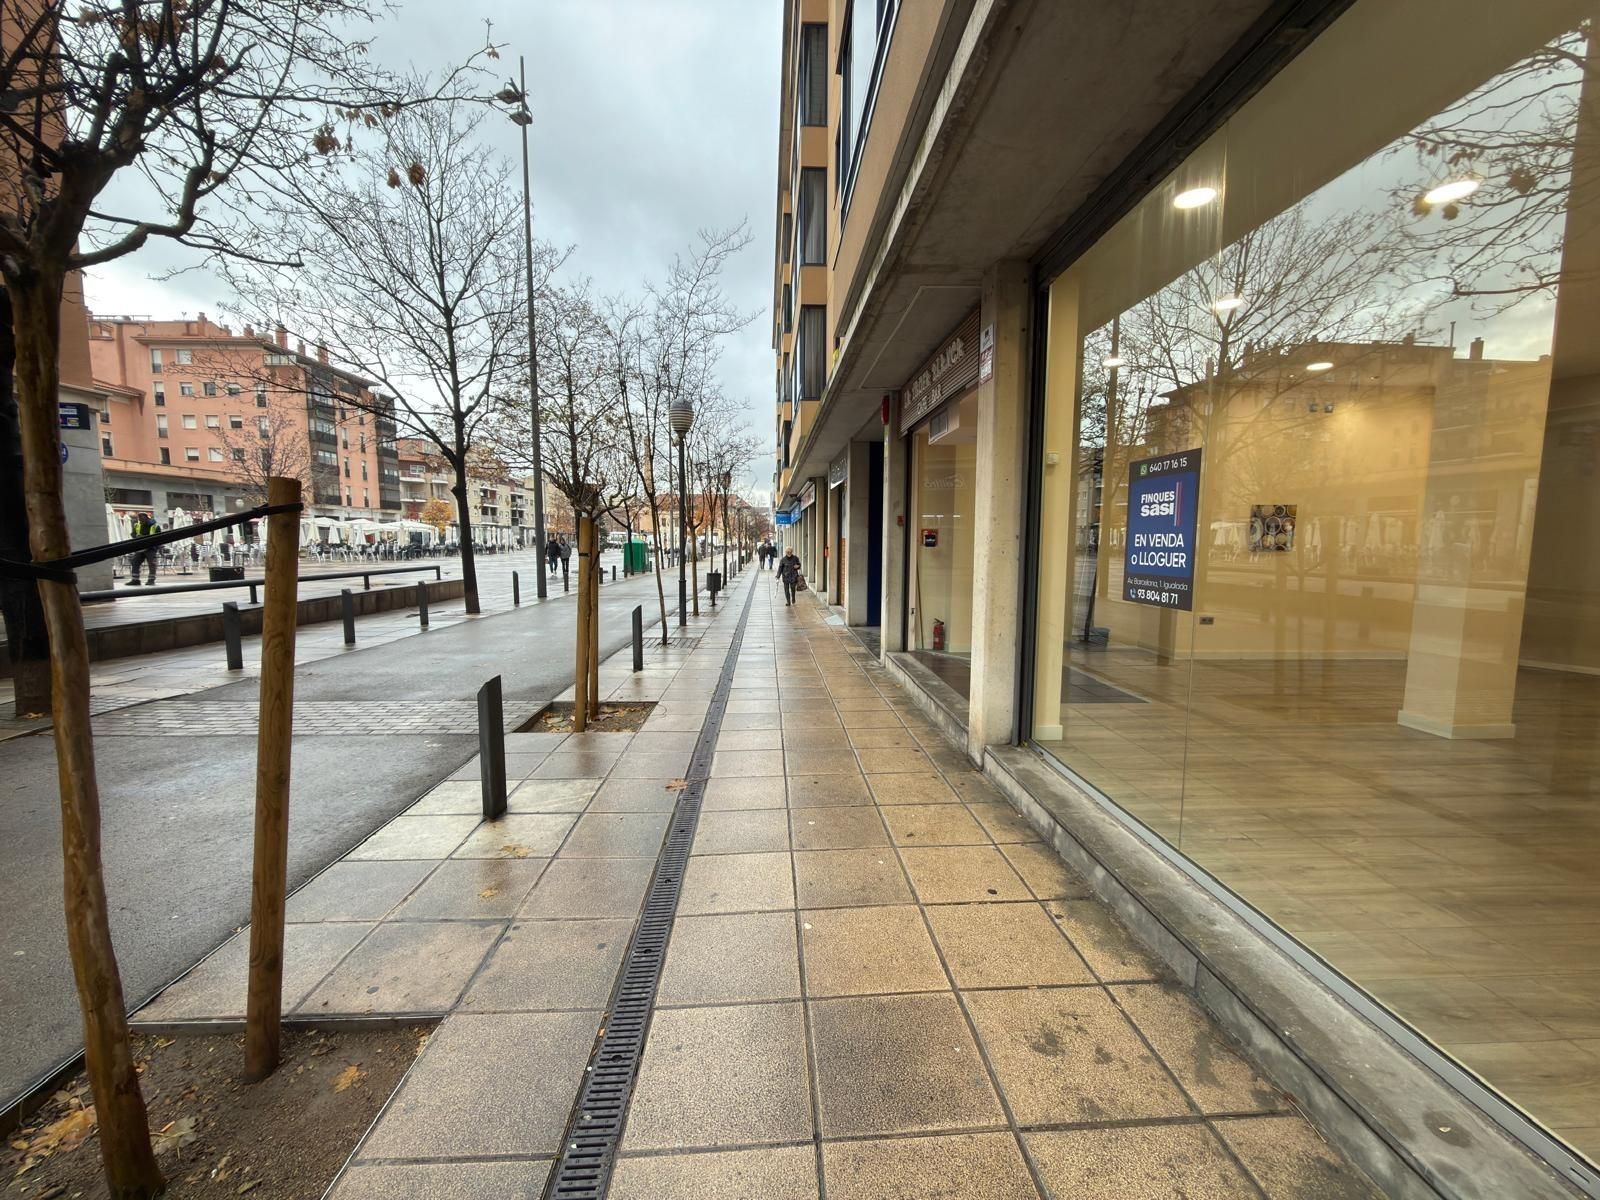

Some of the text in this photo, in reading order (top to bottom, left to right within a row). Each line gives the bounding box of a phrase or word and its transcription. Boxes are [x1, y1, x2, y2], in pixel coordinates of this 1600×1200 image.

[1150, 457, 1187, 472] 640 17 16 15
[1141, 491, 1174, 503] FINQUES
[1140, 503, 1174, 517] sasi
[1135, 534, 1184, 547] EN VENDA
[1131, 552, 1186, 567] o LLOGUER
[1138, 589, 1178, 604] 93 804 81 71
